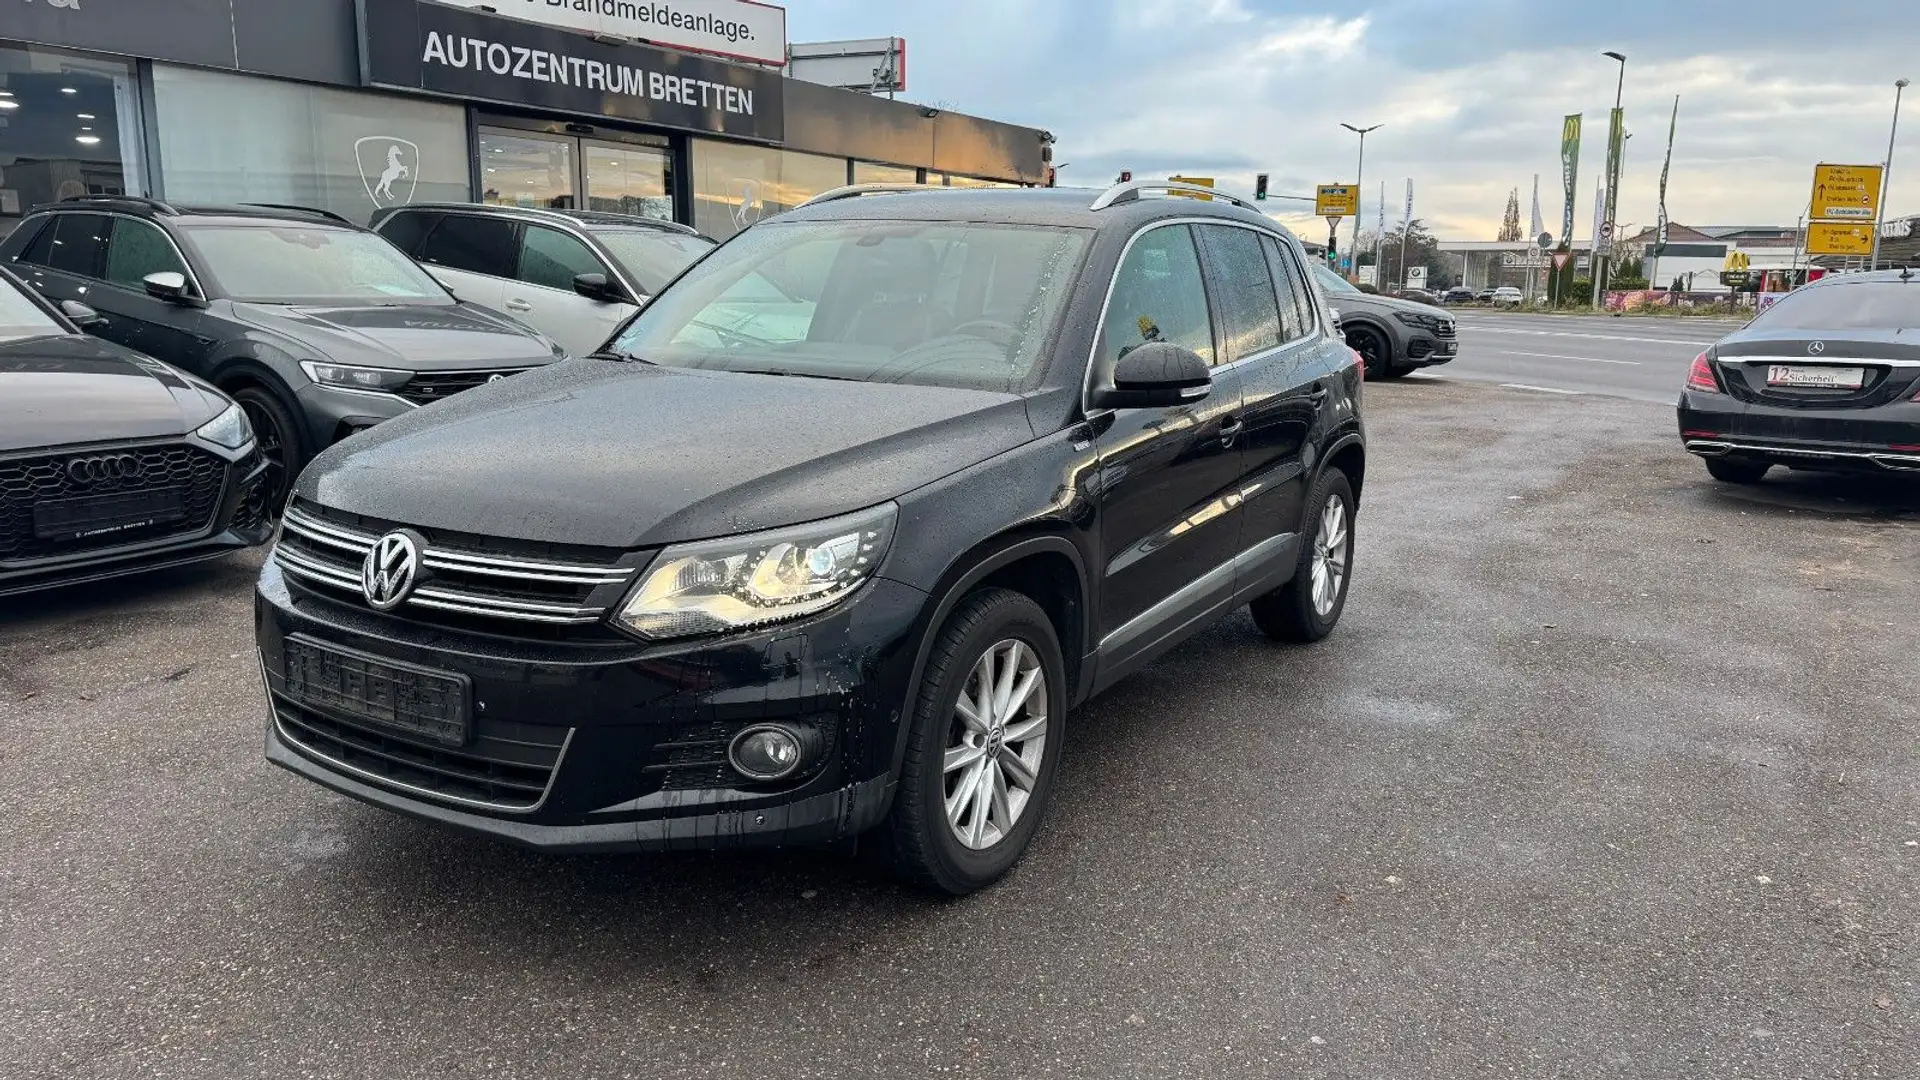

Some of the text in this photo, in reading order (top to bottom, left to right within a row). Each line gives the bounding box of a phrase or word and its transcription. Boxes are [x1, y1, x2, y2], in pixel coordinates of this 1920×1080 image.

[546, 0, 755, 42] randmeldeanlage.
[423, 31, 753, 115] AUTOZENTRUM BRETTEN
[1771, 367, 1790, 381] 12
